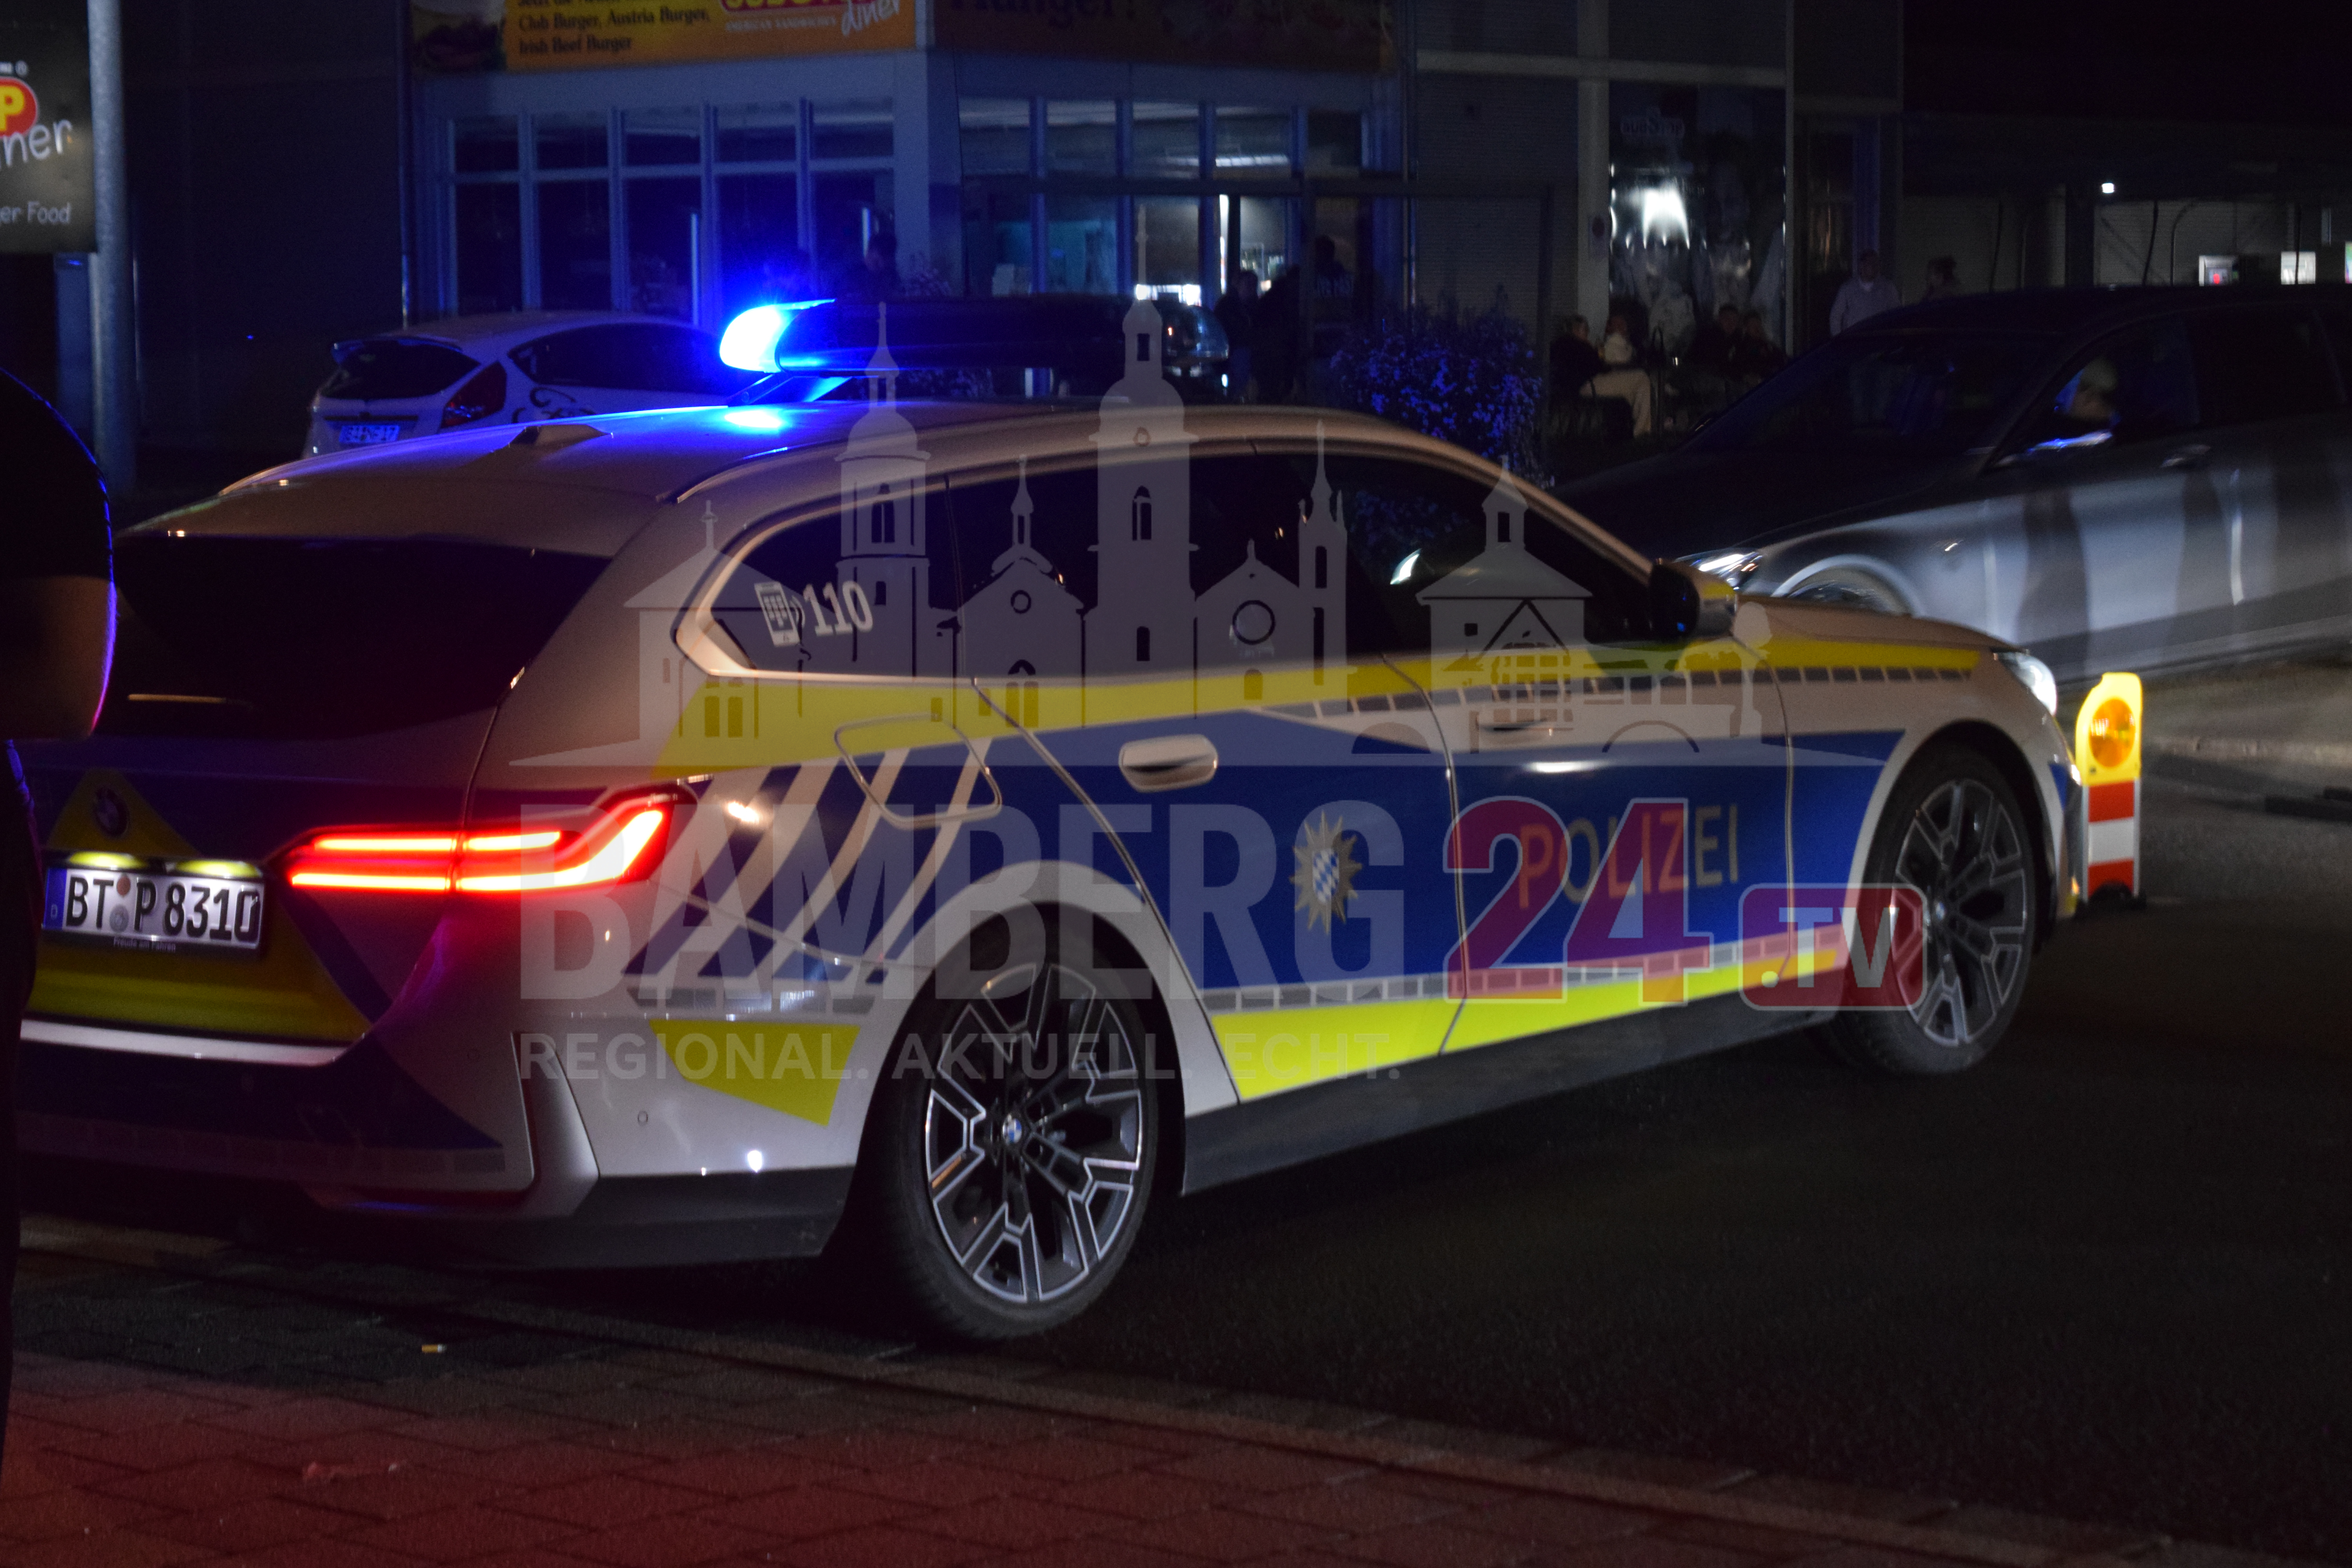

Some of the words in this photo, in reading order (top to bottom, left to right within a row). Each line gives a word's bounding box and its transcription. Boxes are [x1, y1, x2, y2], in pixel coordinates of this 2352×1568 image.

[27, 201, 71, 224] Food
[802, 580, 874, 637] 110
[1518, 803, 1739, 909] POLIZEI
[66, 876, 114, 929] BT
[134, 880, 156, 932] P
[163, 882, 260, 942] 8310
